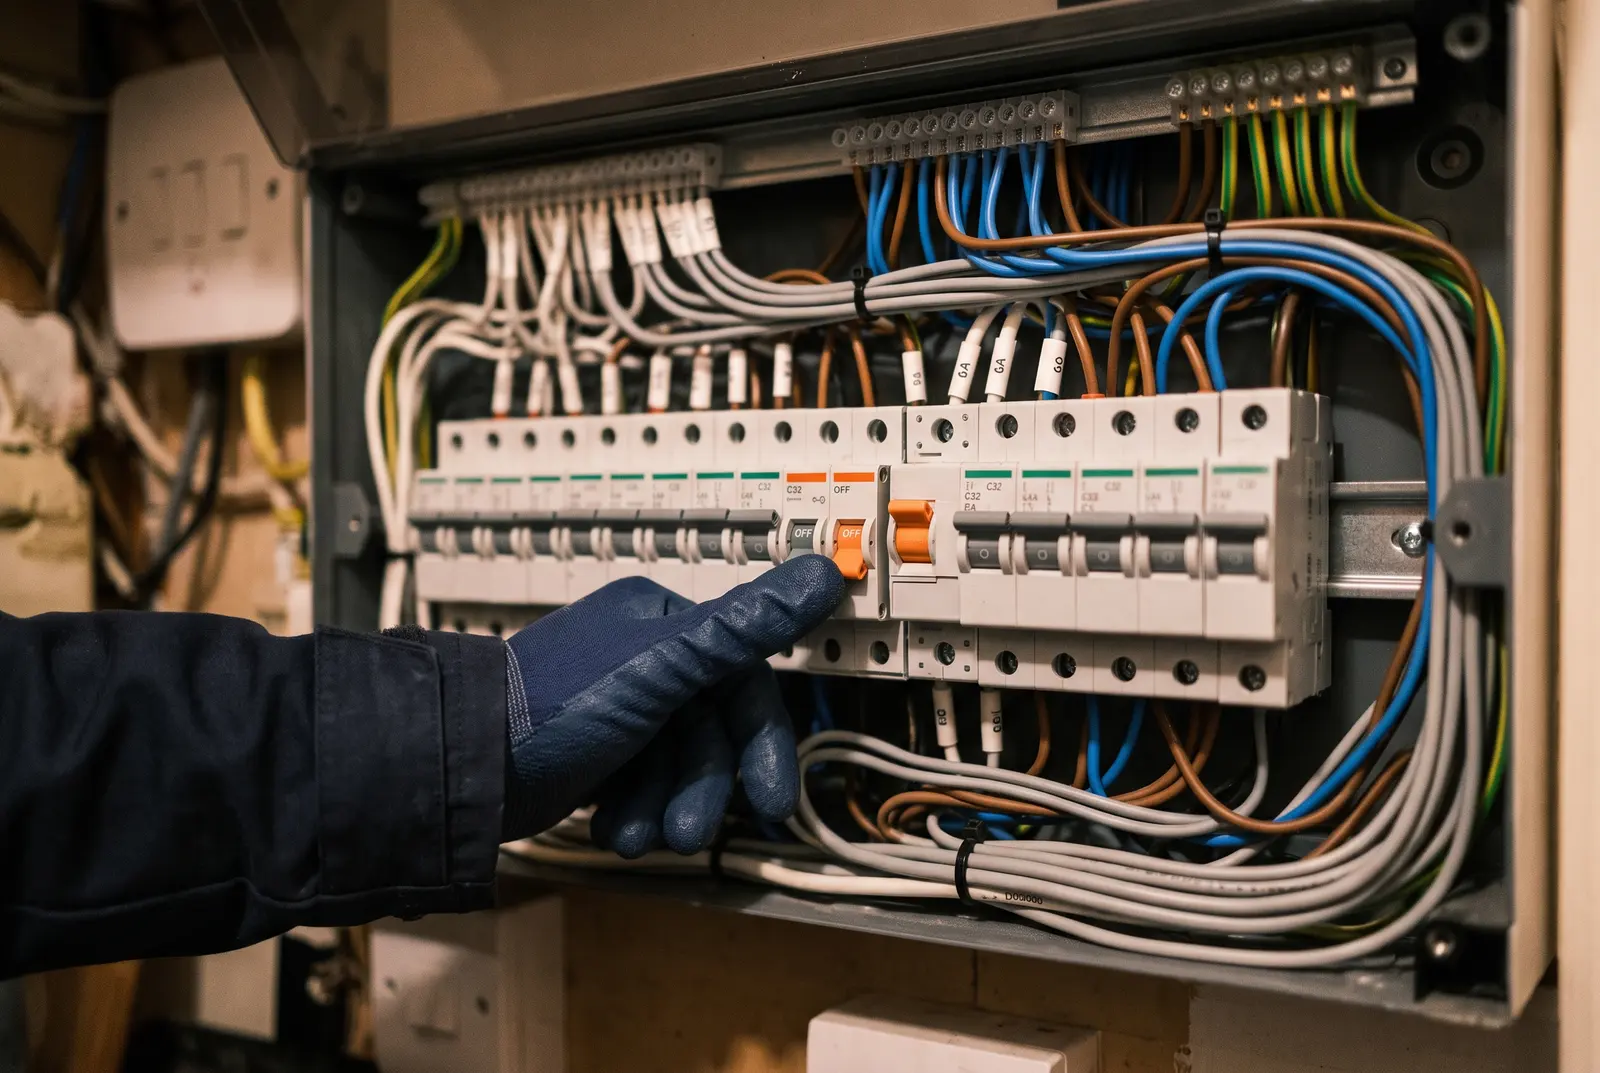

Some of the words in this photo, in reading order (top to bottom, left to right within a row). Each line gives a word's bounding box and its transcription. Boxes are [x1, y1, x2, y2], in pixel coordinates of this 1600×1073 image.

[786, 485, 802, 494] C32
[833, 486, 850, 494] OFF
[986, 482, 1002, 491] C32
[964, 492, 981, 501] C32
[794, 528, 813, 538] OFF
[842, 528, 861, 538] OFF
